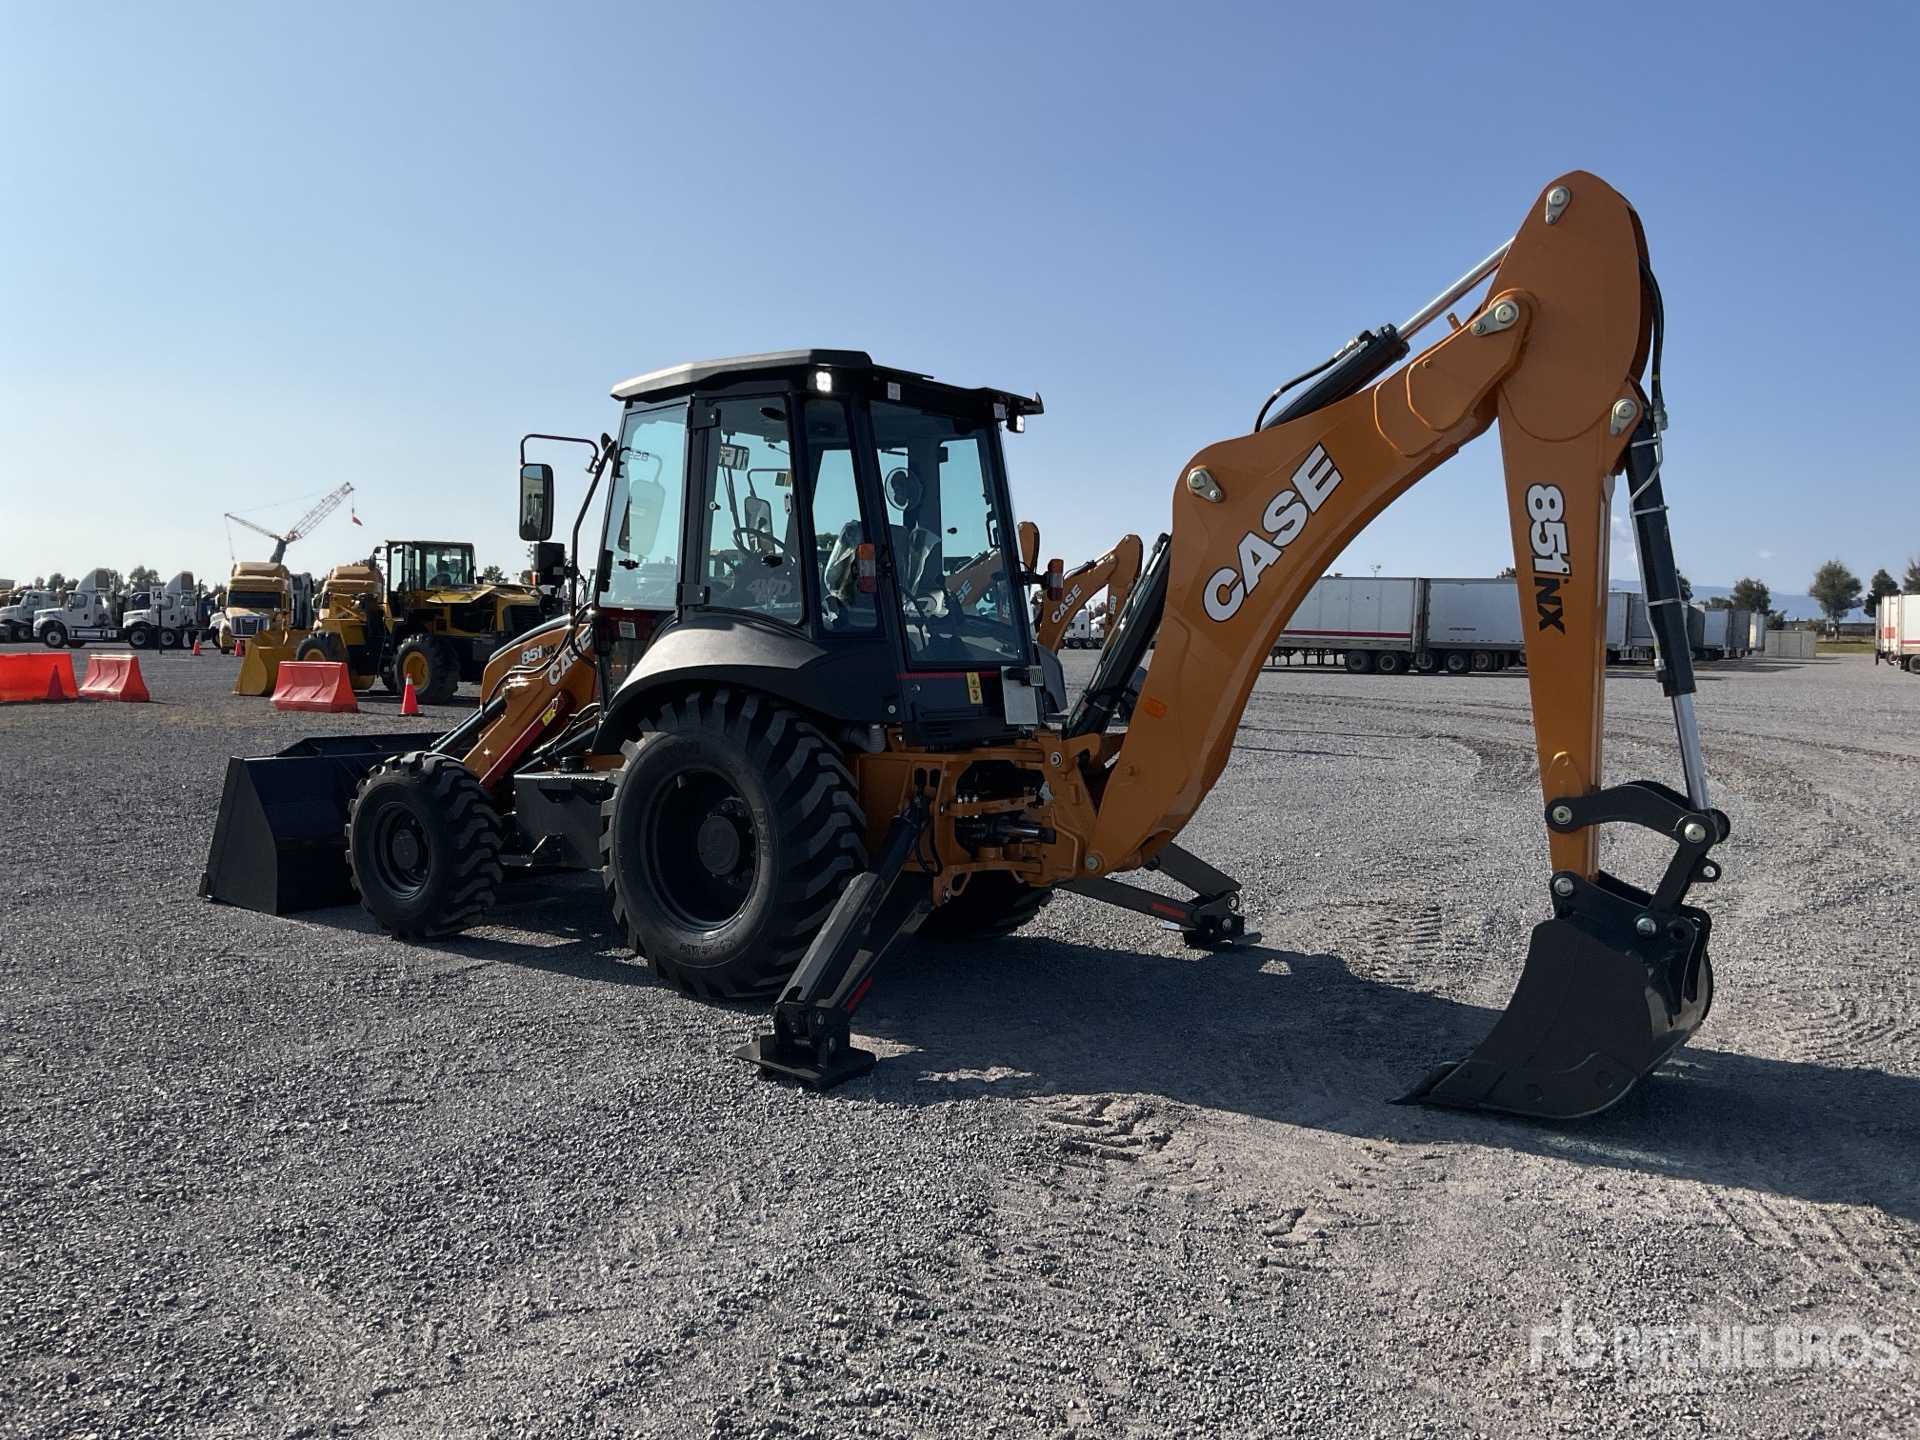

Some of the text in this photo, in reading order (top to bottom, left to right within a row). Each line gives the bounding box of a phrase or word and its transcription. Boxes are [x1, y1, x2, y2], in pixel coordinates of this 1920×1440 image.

[1202, 441, 1344, 622] CASE
[151, 591, 163, 601] 14
[1051, 583, 1082, 624] CASE
